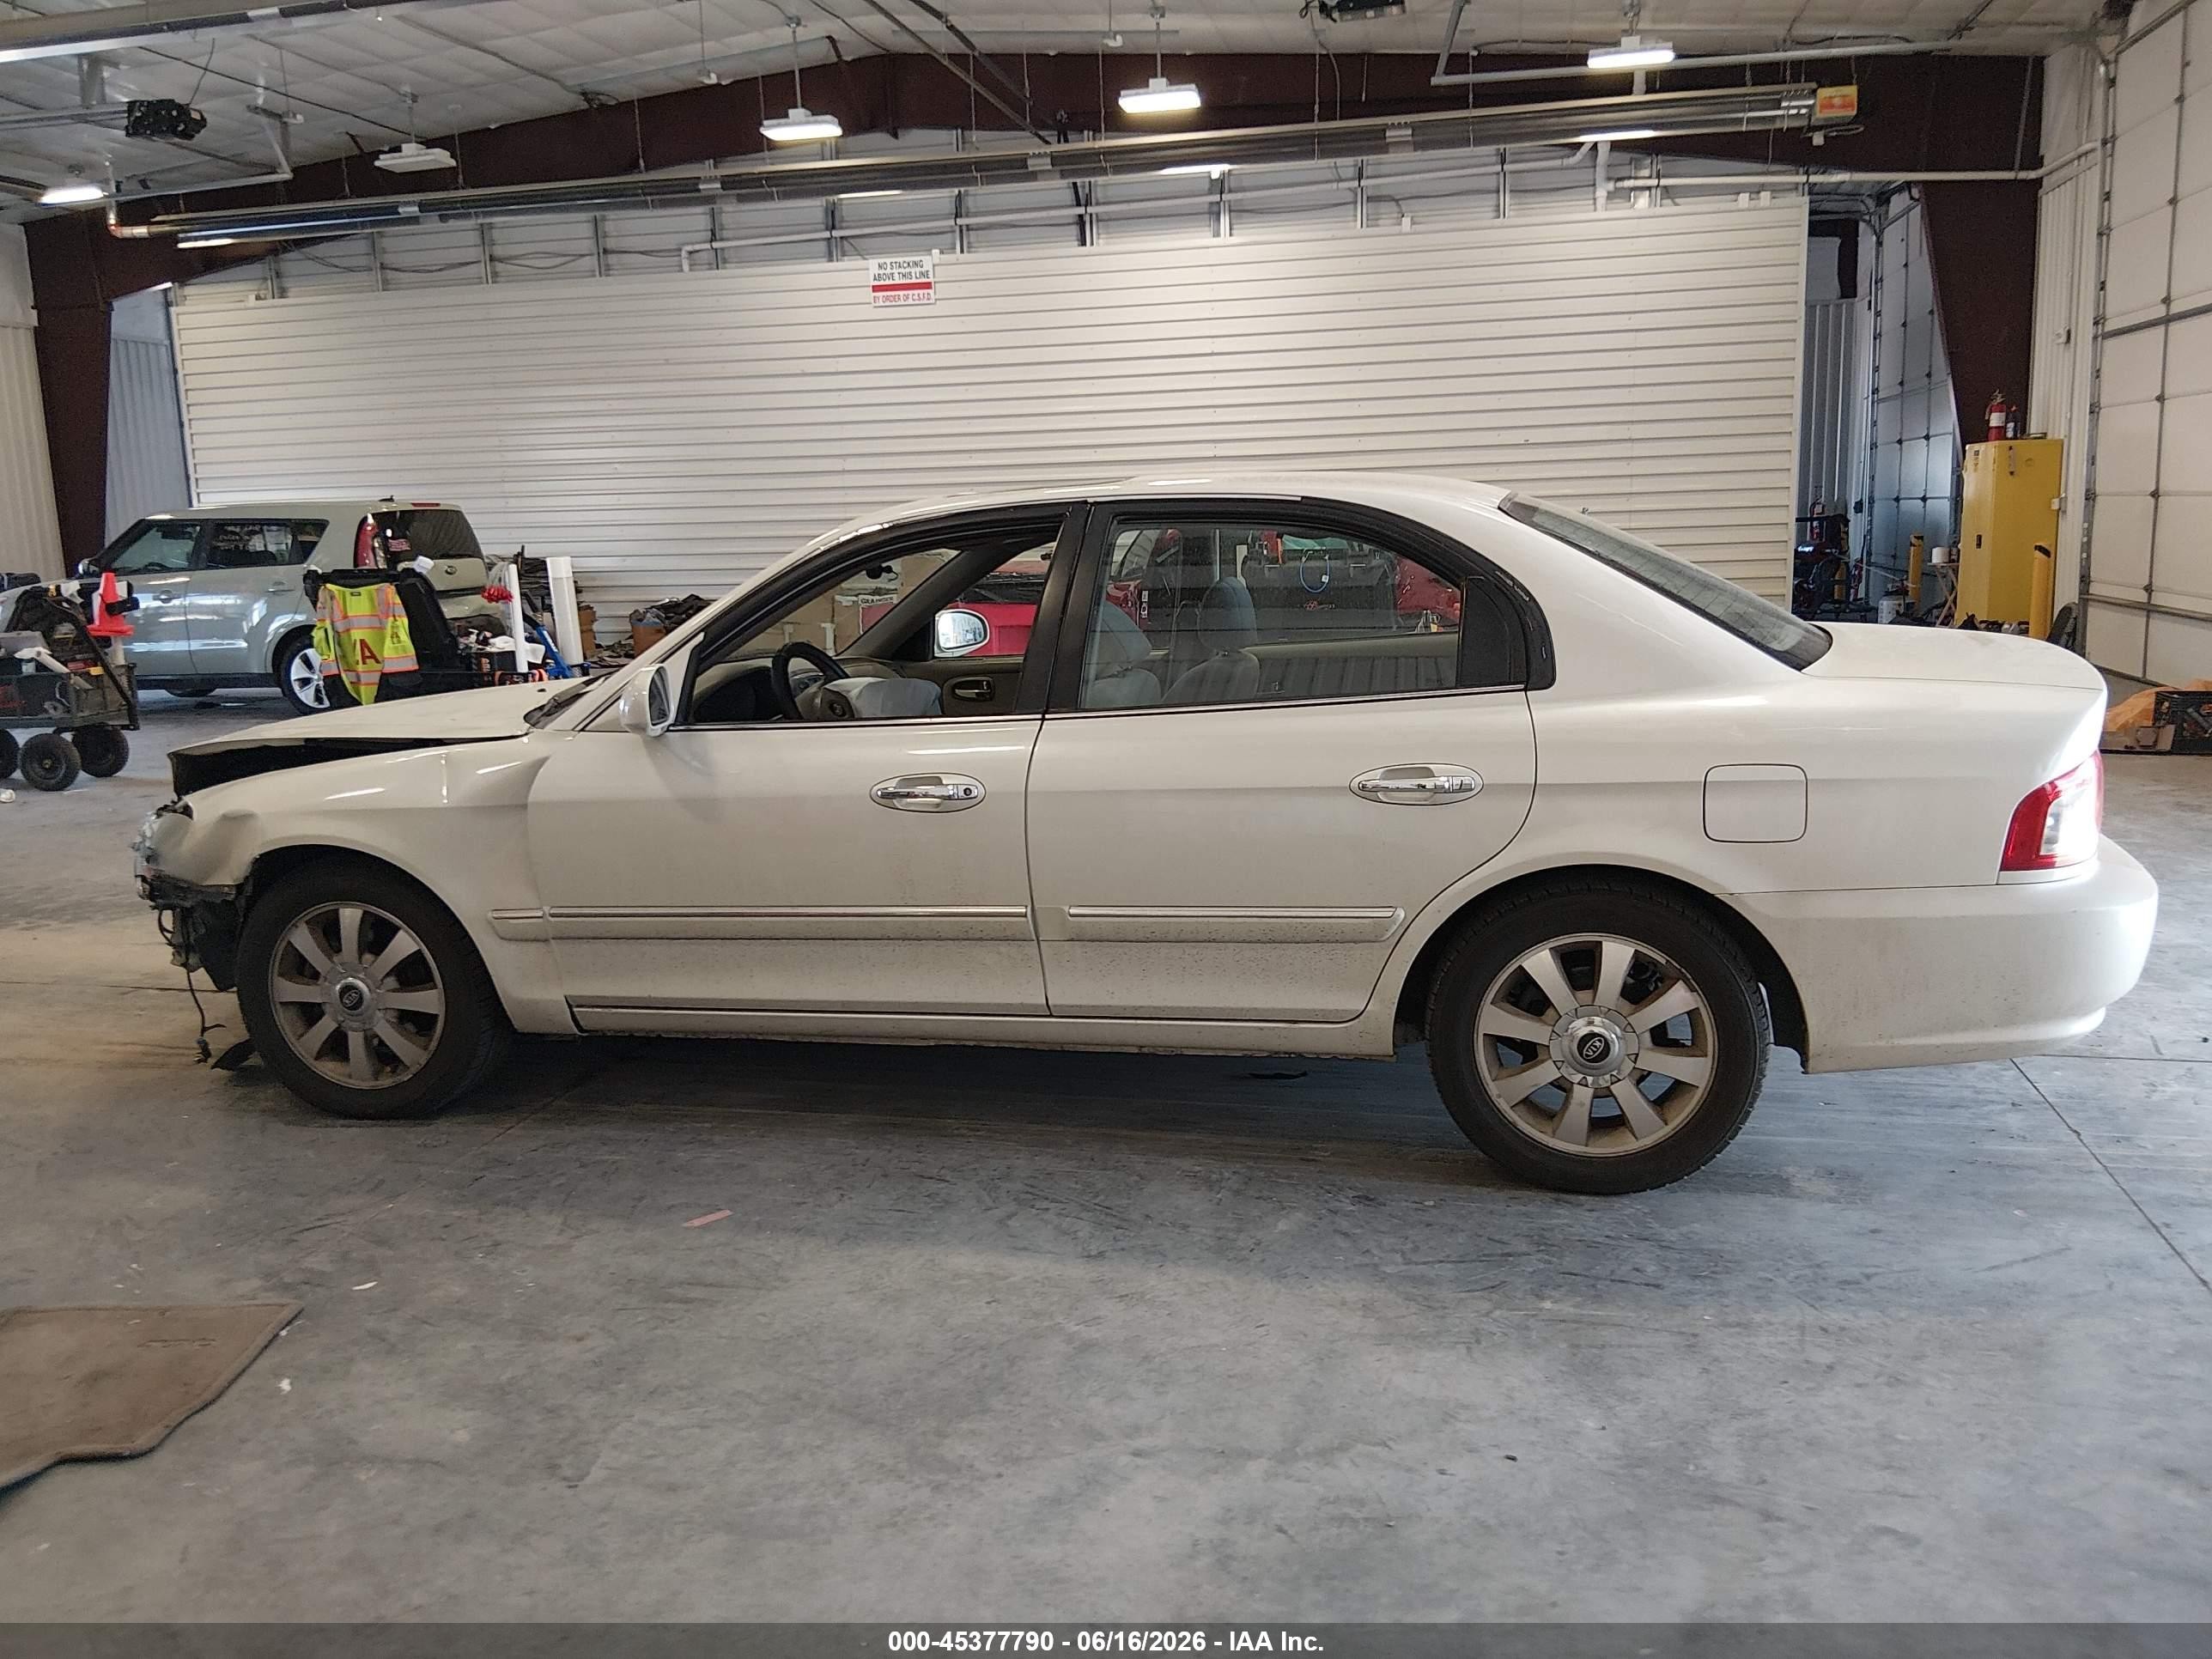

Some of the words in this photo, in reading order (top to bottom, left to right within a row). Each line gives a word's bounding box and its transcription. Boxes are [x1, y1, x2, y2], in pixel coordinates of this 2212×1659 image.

[878, 262, 888, 270] NO
[890, 259, 924, 270] STACKING
[873, 272, 896, 282] ABOVE
[897, 271, 913, 280] THIS
[915, 270, 930, 279] LINE
[873, 295, 880, 304] BY
[882, 294, 902, 303] ORDER
[1584, 1038, 1603, 1057] KIA
